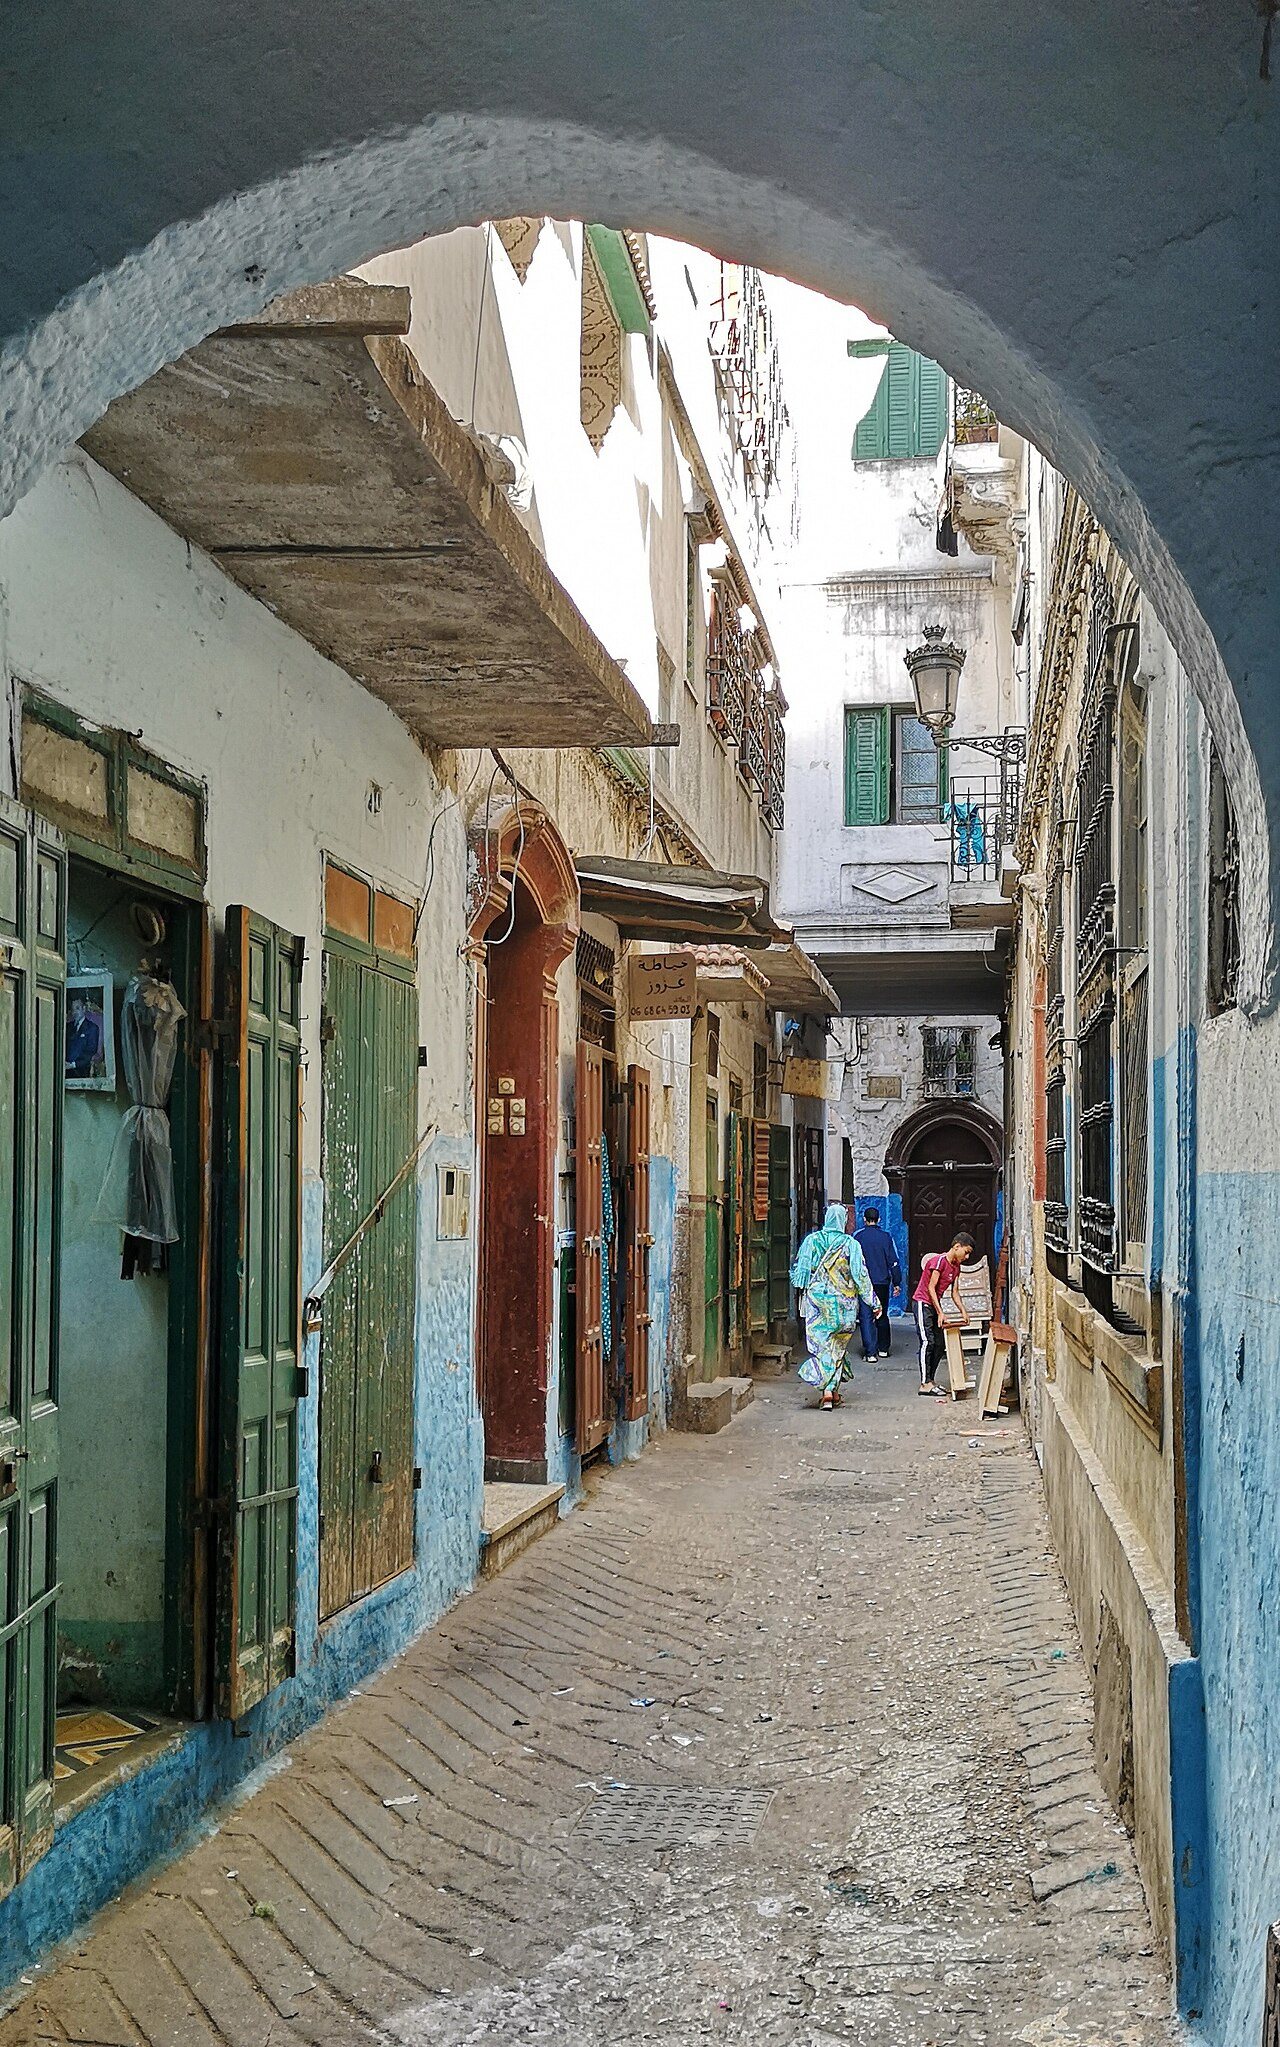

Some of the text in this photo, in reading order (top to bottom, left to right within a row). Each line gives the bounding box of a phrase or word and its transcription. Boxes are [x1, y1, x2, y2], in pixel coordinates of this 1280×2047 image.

[638, 957, 688, 971] خياطة
[646, 978, 685, 995] عزوز
[630, 1007, 641, 1016] 06
[644, 1006, 654, 1015] 68
[668, 1004, 679, 1014] 59
[680, 1004, 690, 1014] 03
